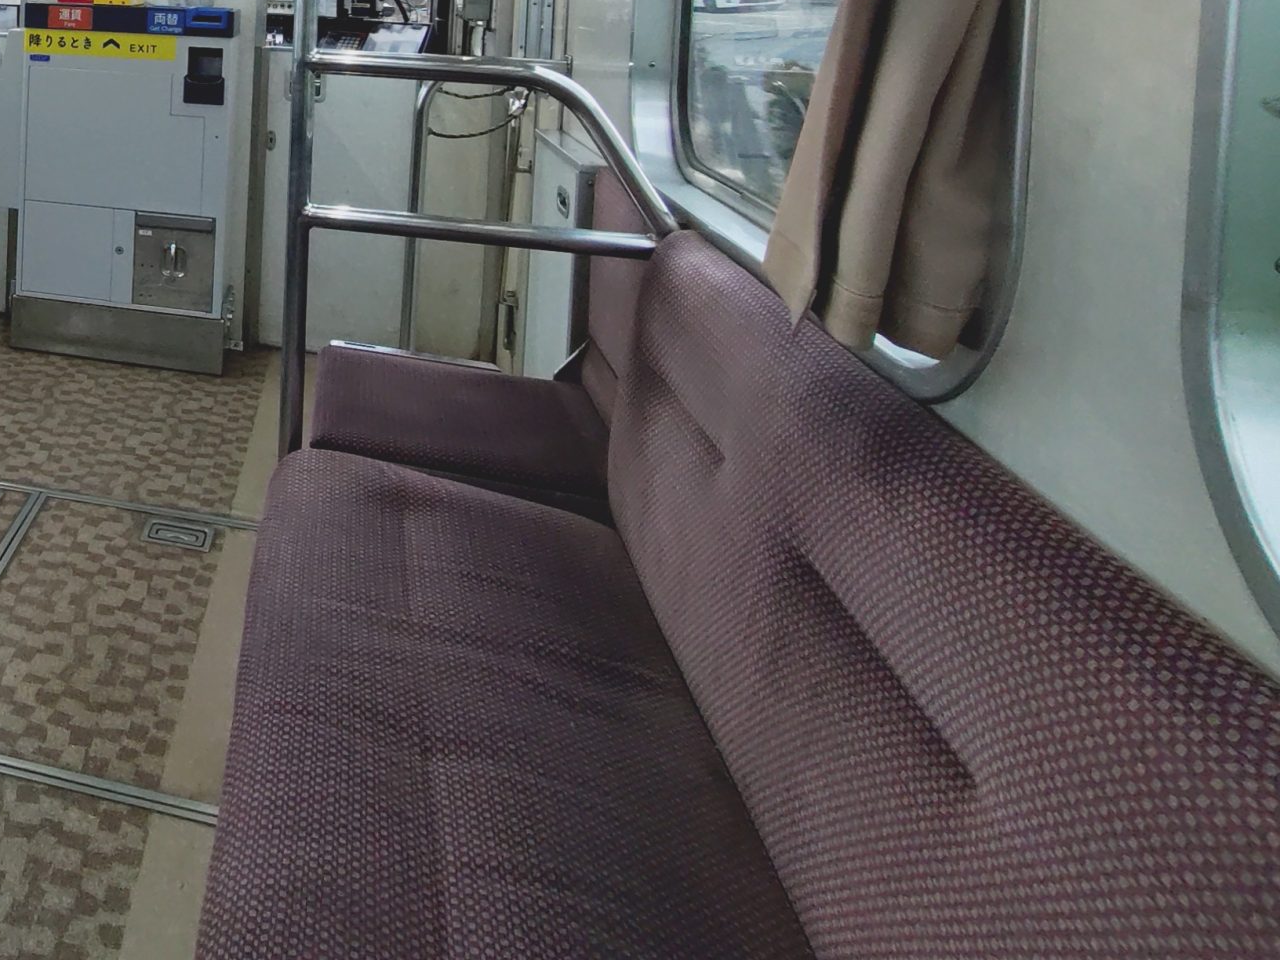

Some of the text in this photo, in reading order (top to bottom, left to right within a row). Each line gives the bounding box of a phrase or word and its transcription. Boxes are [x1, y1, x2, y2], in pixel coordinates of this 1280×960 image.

[58, 8, 82, 20] 運賃
[154, 12, 179, 25] 両替
[28, 33, 157, 53] 降りるとき EXIT
